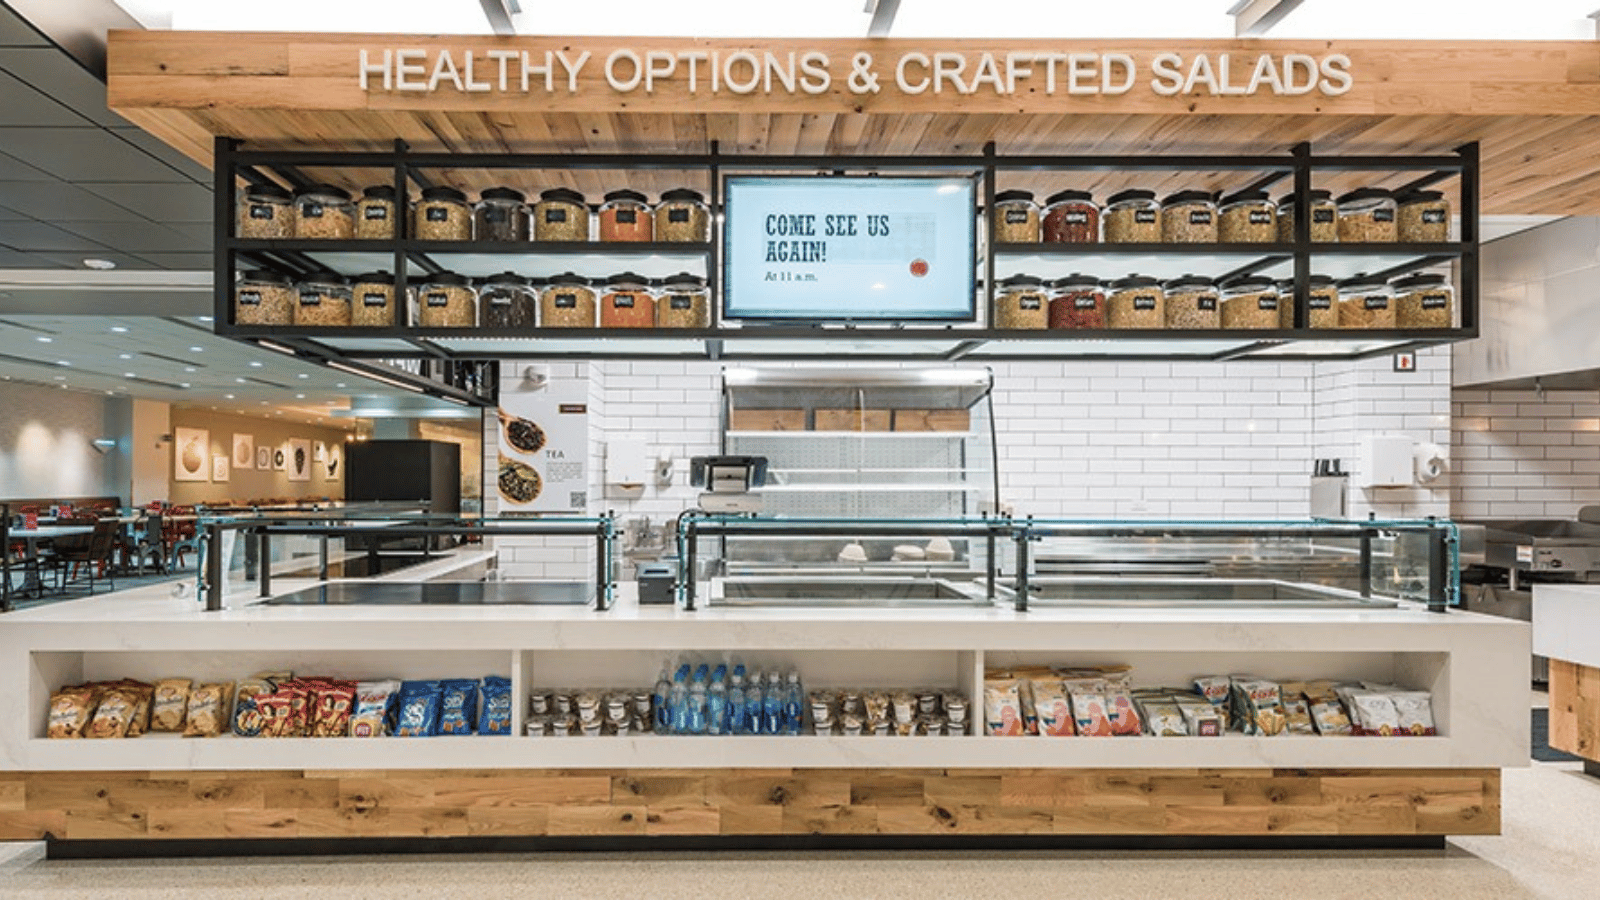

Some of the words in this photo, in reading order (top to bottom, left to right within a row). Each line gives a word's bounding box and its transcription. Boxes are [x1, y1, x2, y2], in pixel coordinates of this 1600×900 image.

[358, 48, 592, 92] HEALTHY
[604, 49, 832, 95] OPTIONS
[847, 51, 881, 95] &
[895, 51, 1137, 95] CRAFTED
[1150, 52, 1354, 97] SALADS
[765, 214, 816, 237] COME
[825, 214, 858, 237] SEE
[867, 214, 890, 237] US
[765, 240, 827, 263] AGAIN!
[764, 271, 778, 282] At
[780, 271, 792, 282] 11
[545, 449, 565, 459] TEA
